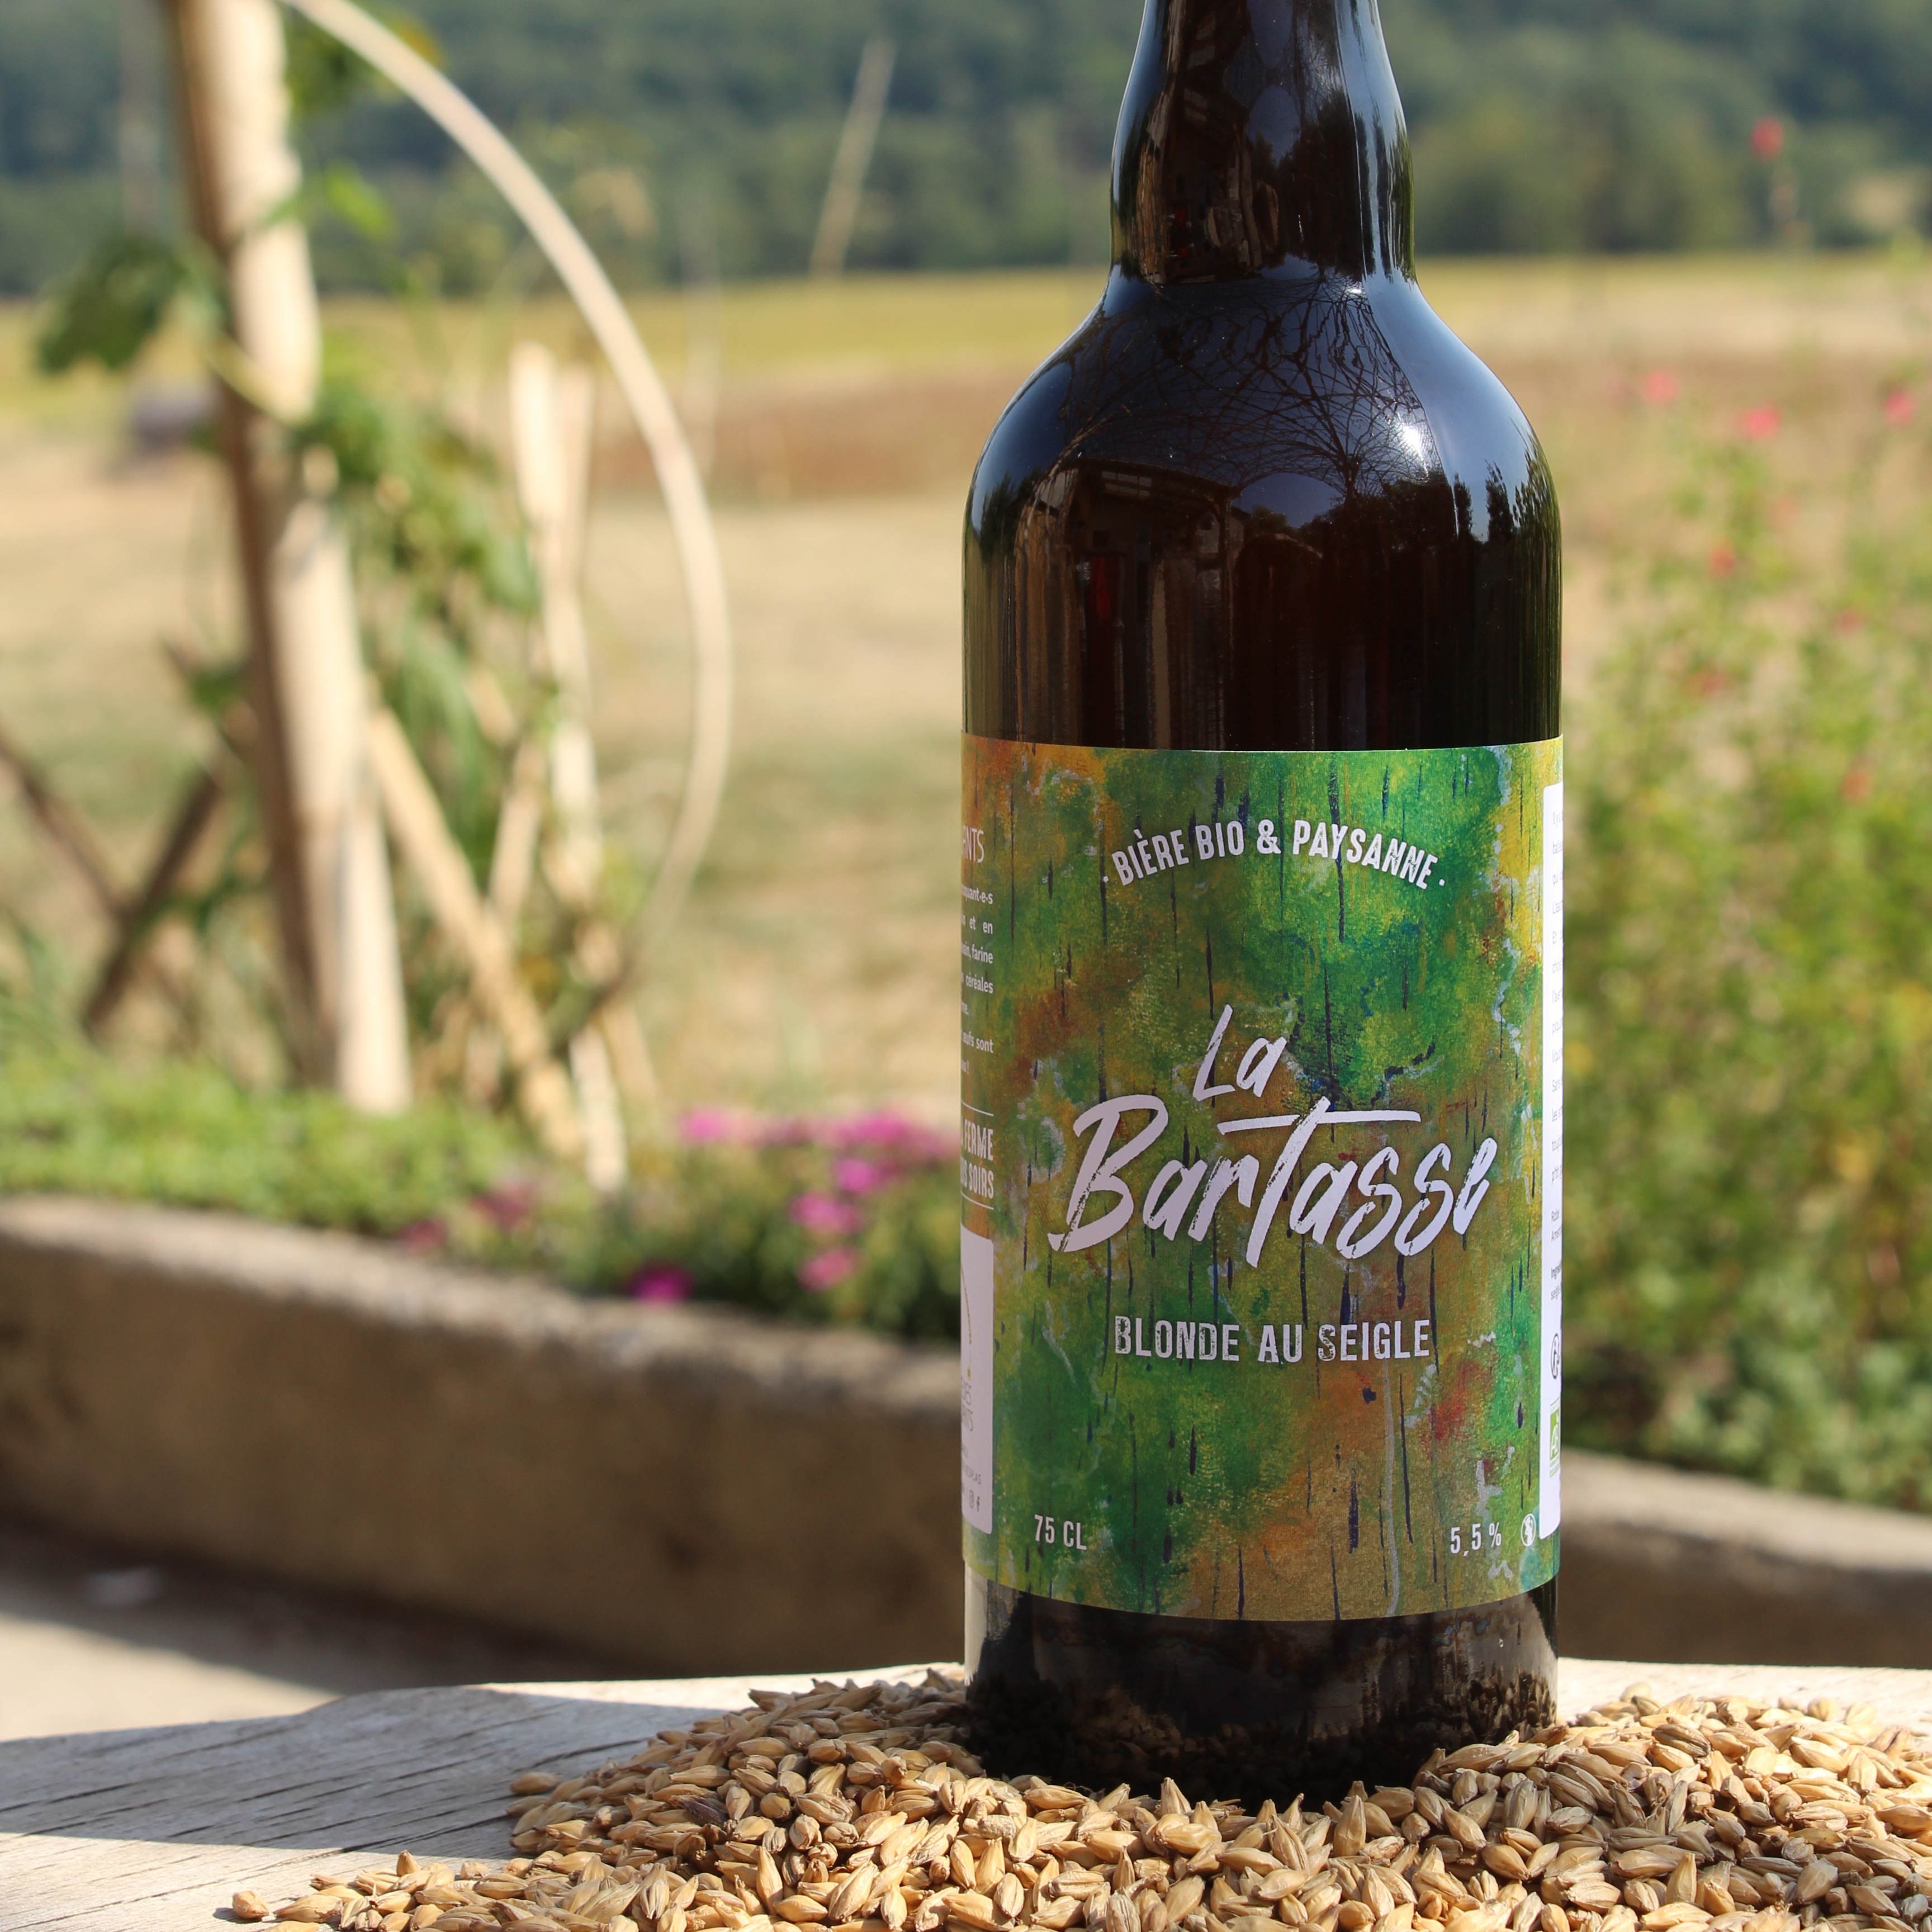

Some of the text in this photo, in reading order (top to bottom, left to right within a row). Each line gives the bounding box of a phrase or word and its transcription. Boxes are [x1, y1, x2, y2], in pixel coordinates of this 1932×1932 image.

[1111, 818, 1439, 890] BIÈRE BIO & PAYSANNE
[969, 916, 976, 930] et
[983, 921, 993, 935] en
[972, 944, 993, 964] farine
[965, 971, 993, 994] céréales
[976, 1039, 994, 1053] sont
[1192, 1003, 1287, 1102] La
[964, 1119, 994, 1161] FERME
[969, 1162, 995, 1199] SOIRS
[1114, 1315, 1431, 1363] BLONDE AU SEIGLE
[1034, 1514, 1087, 1550] 75 CL
[1450, 1521, 1502, 1557] 5,5 %
